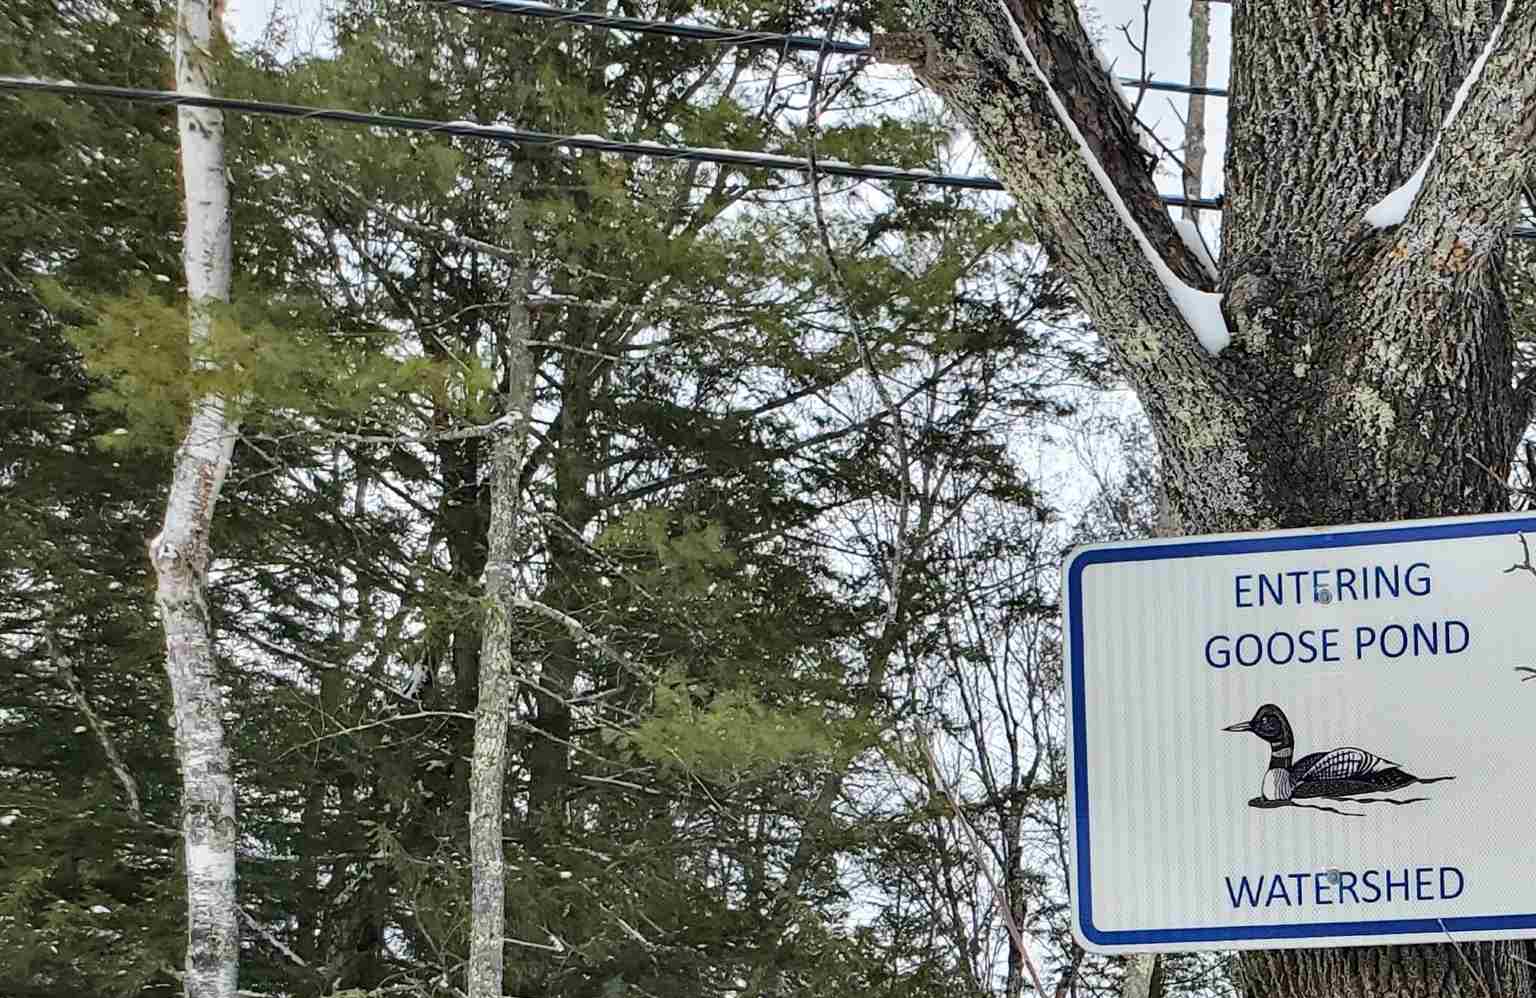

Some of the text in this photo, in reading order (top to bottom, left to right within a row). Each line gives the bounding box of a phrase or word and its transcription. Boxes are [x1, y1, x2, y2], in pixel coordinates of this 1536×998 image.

[1234, 562, 1432, 609] ENTERING
[1204, 620, 1470, 669] GOOSE POND
[1224, 866, 1465, 909] WATERSHED
